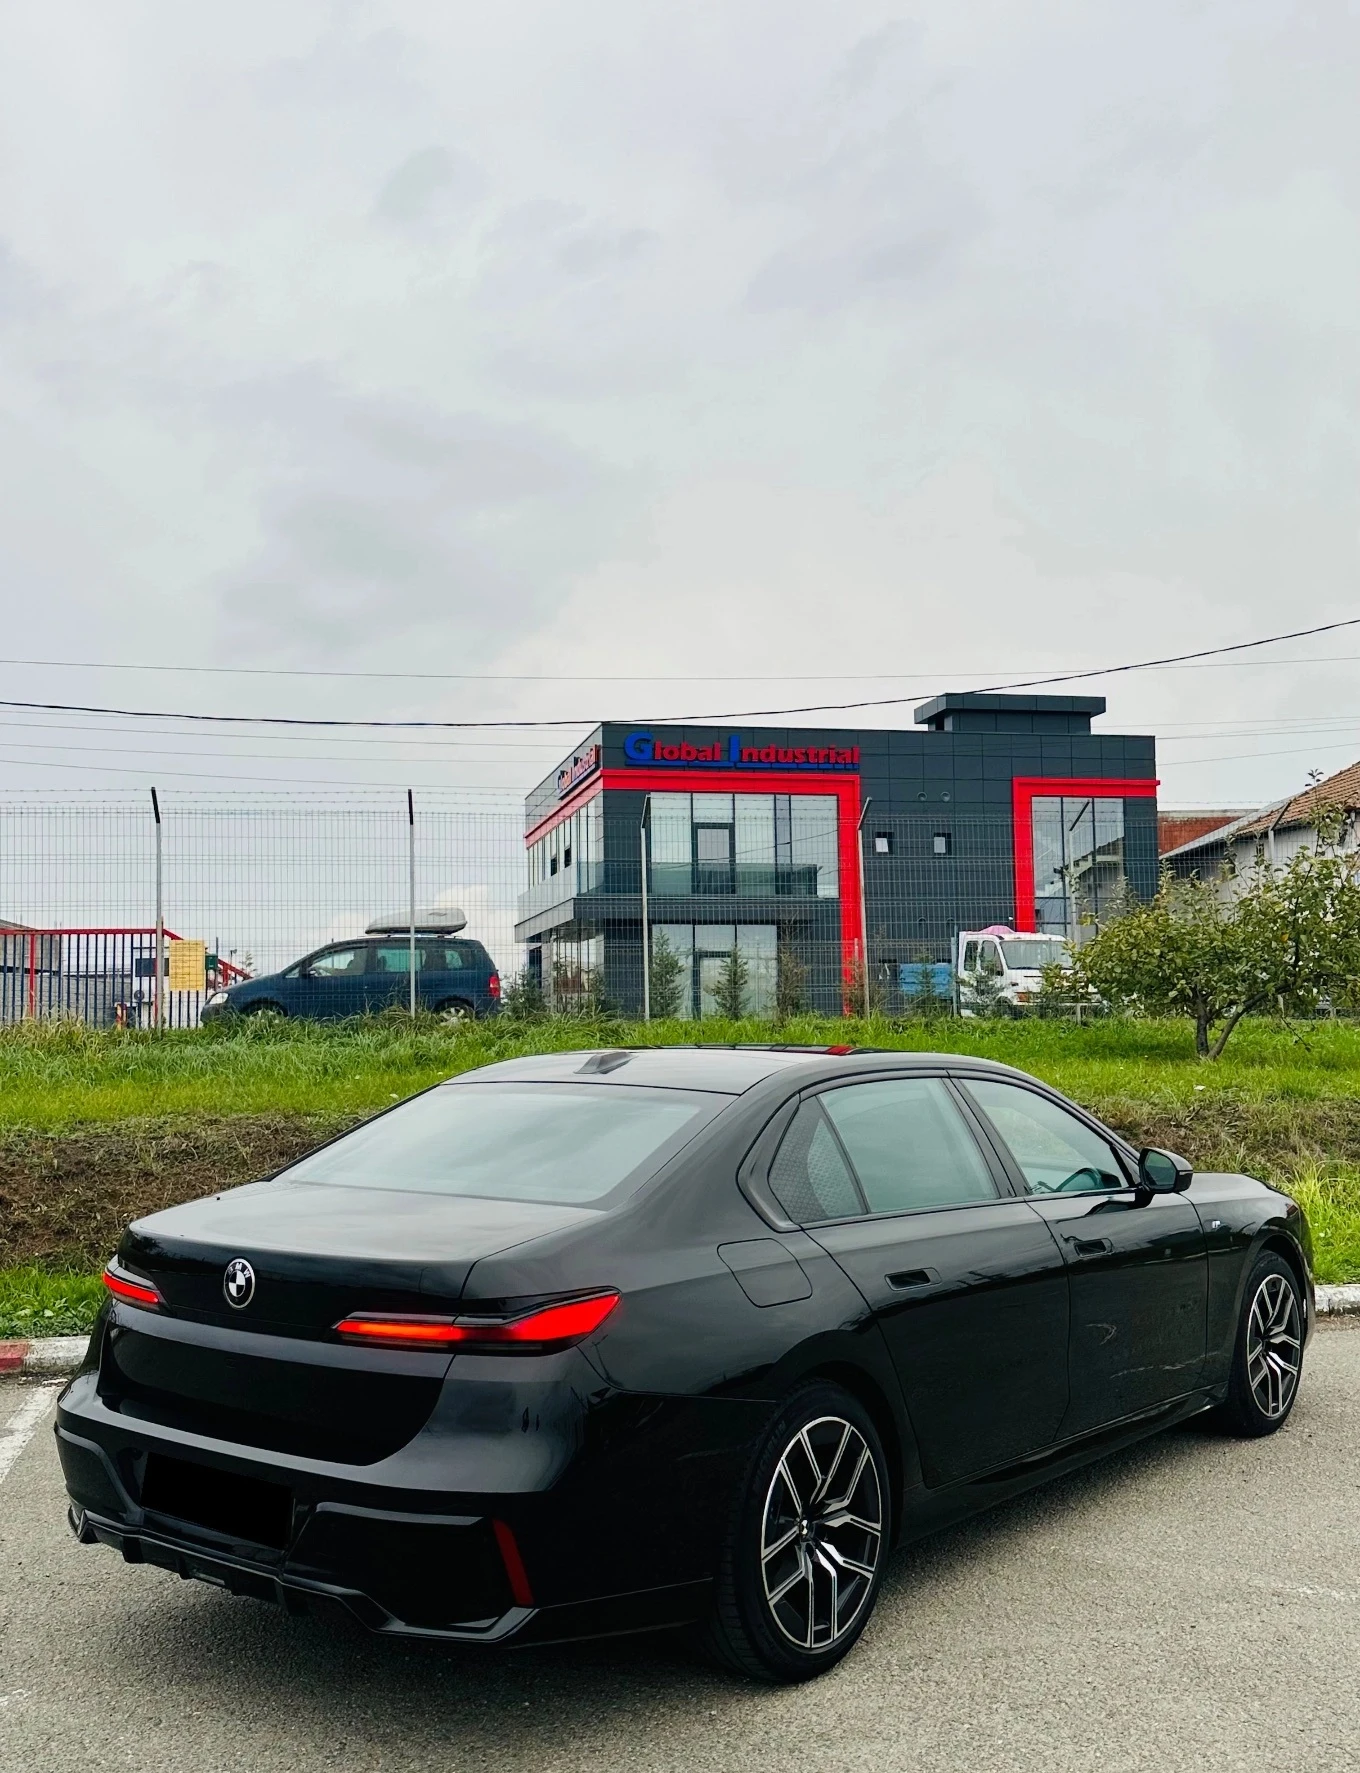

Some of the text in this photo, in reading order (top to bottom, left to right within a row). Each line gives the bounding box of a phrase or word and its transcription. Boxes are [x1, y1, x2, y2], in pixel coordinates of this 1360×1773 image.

[624, 731, 860, 764] Global Industrial
[227, 1262, 251, 1278] BMW
